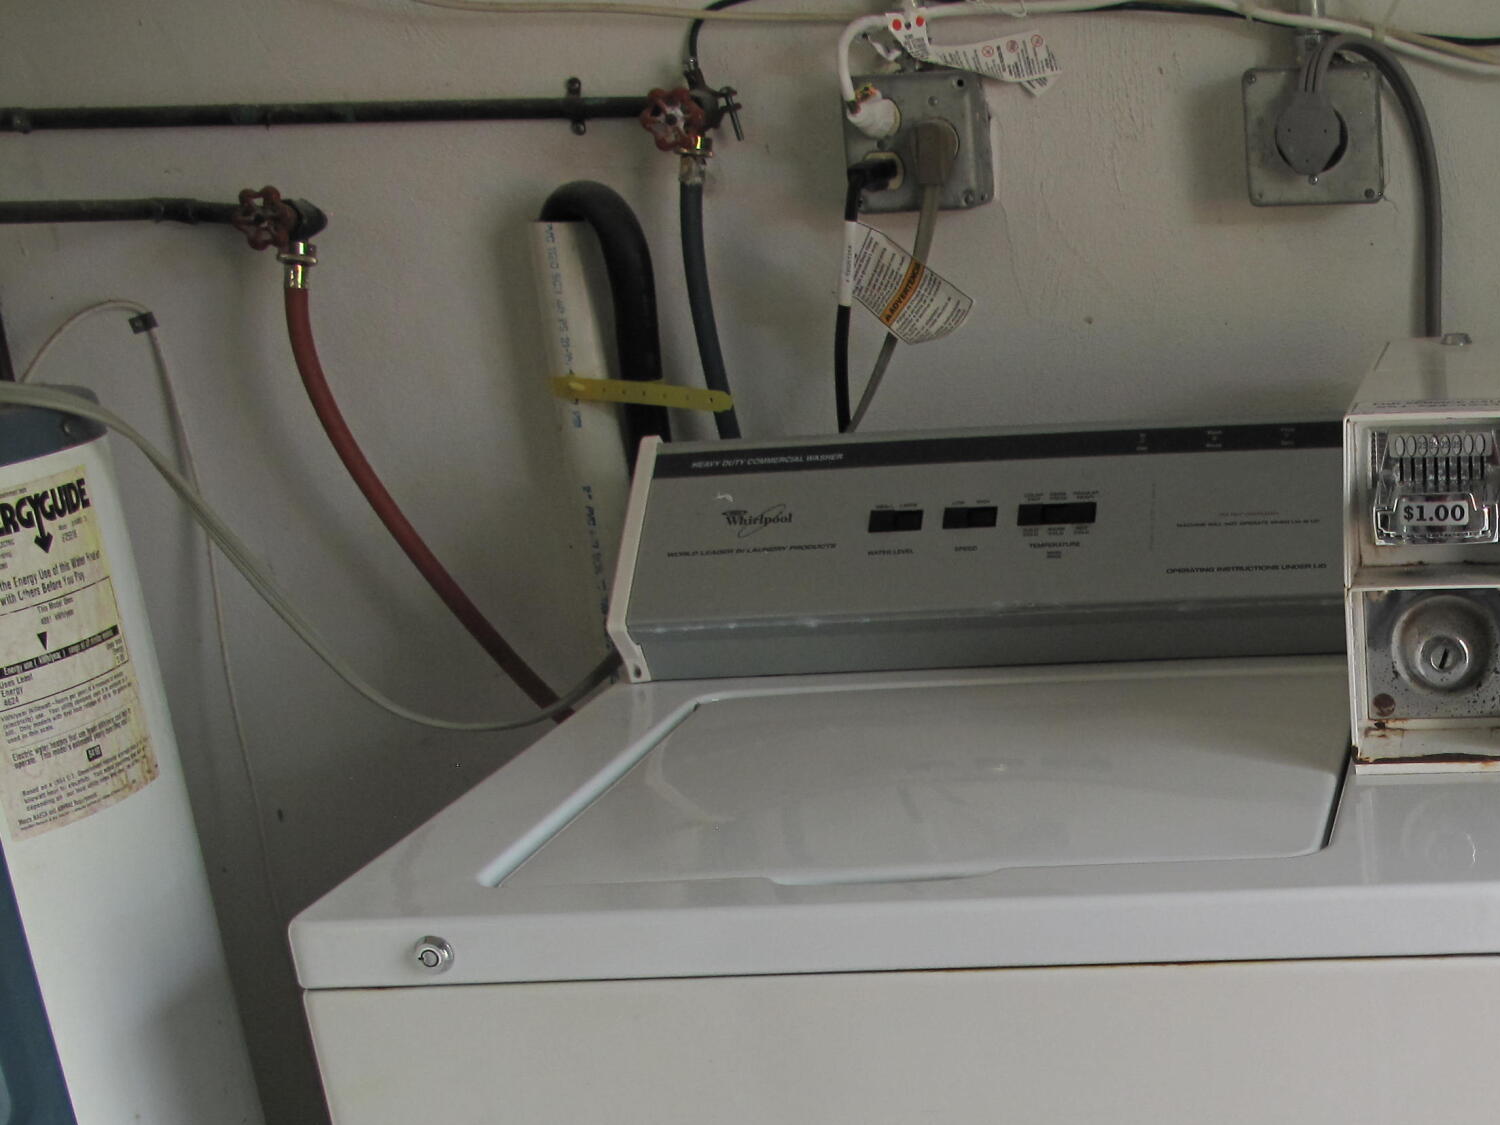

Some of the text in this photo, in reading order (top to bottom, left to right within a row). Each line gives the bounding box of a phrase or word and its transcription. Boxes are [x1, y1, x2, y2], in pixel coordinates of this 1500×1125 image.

[691, 453, 843, 469] HEAVY DUTY COMMERCIAL WASHER
[0, 478, 90, 537] RGYGUIDE
[1403, 503, 1465, 522] $1.00
[725, 511, 793, 527] Whirlpool
[700, 548, 734, 556] LEADER
[746, 546, 788, 554] LAUNDRY
[789, 543, 837, 551] PRODUCTS
[1029, 541, 1080, 549] TEMPERATURE
[13, 572, 38, 587] Energy
[38, 567, 52, 579] Use
[1216, 565, 1280, 573] INSTRUCTIONS
[1, 592, 17, 606] with
[42, 579, 63, 593] Before
[17, 673, 33, 684] Least
[0, 687, 23, 698] Energy
